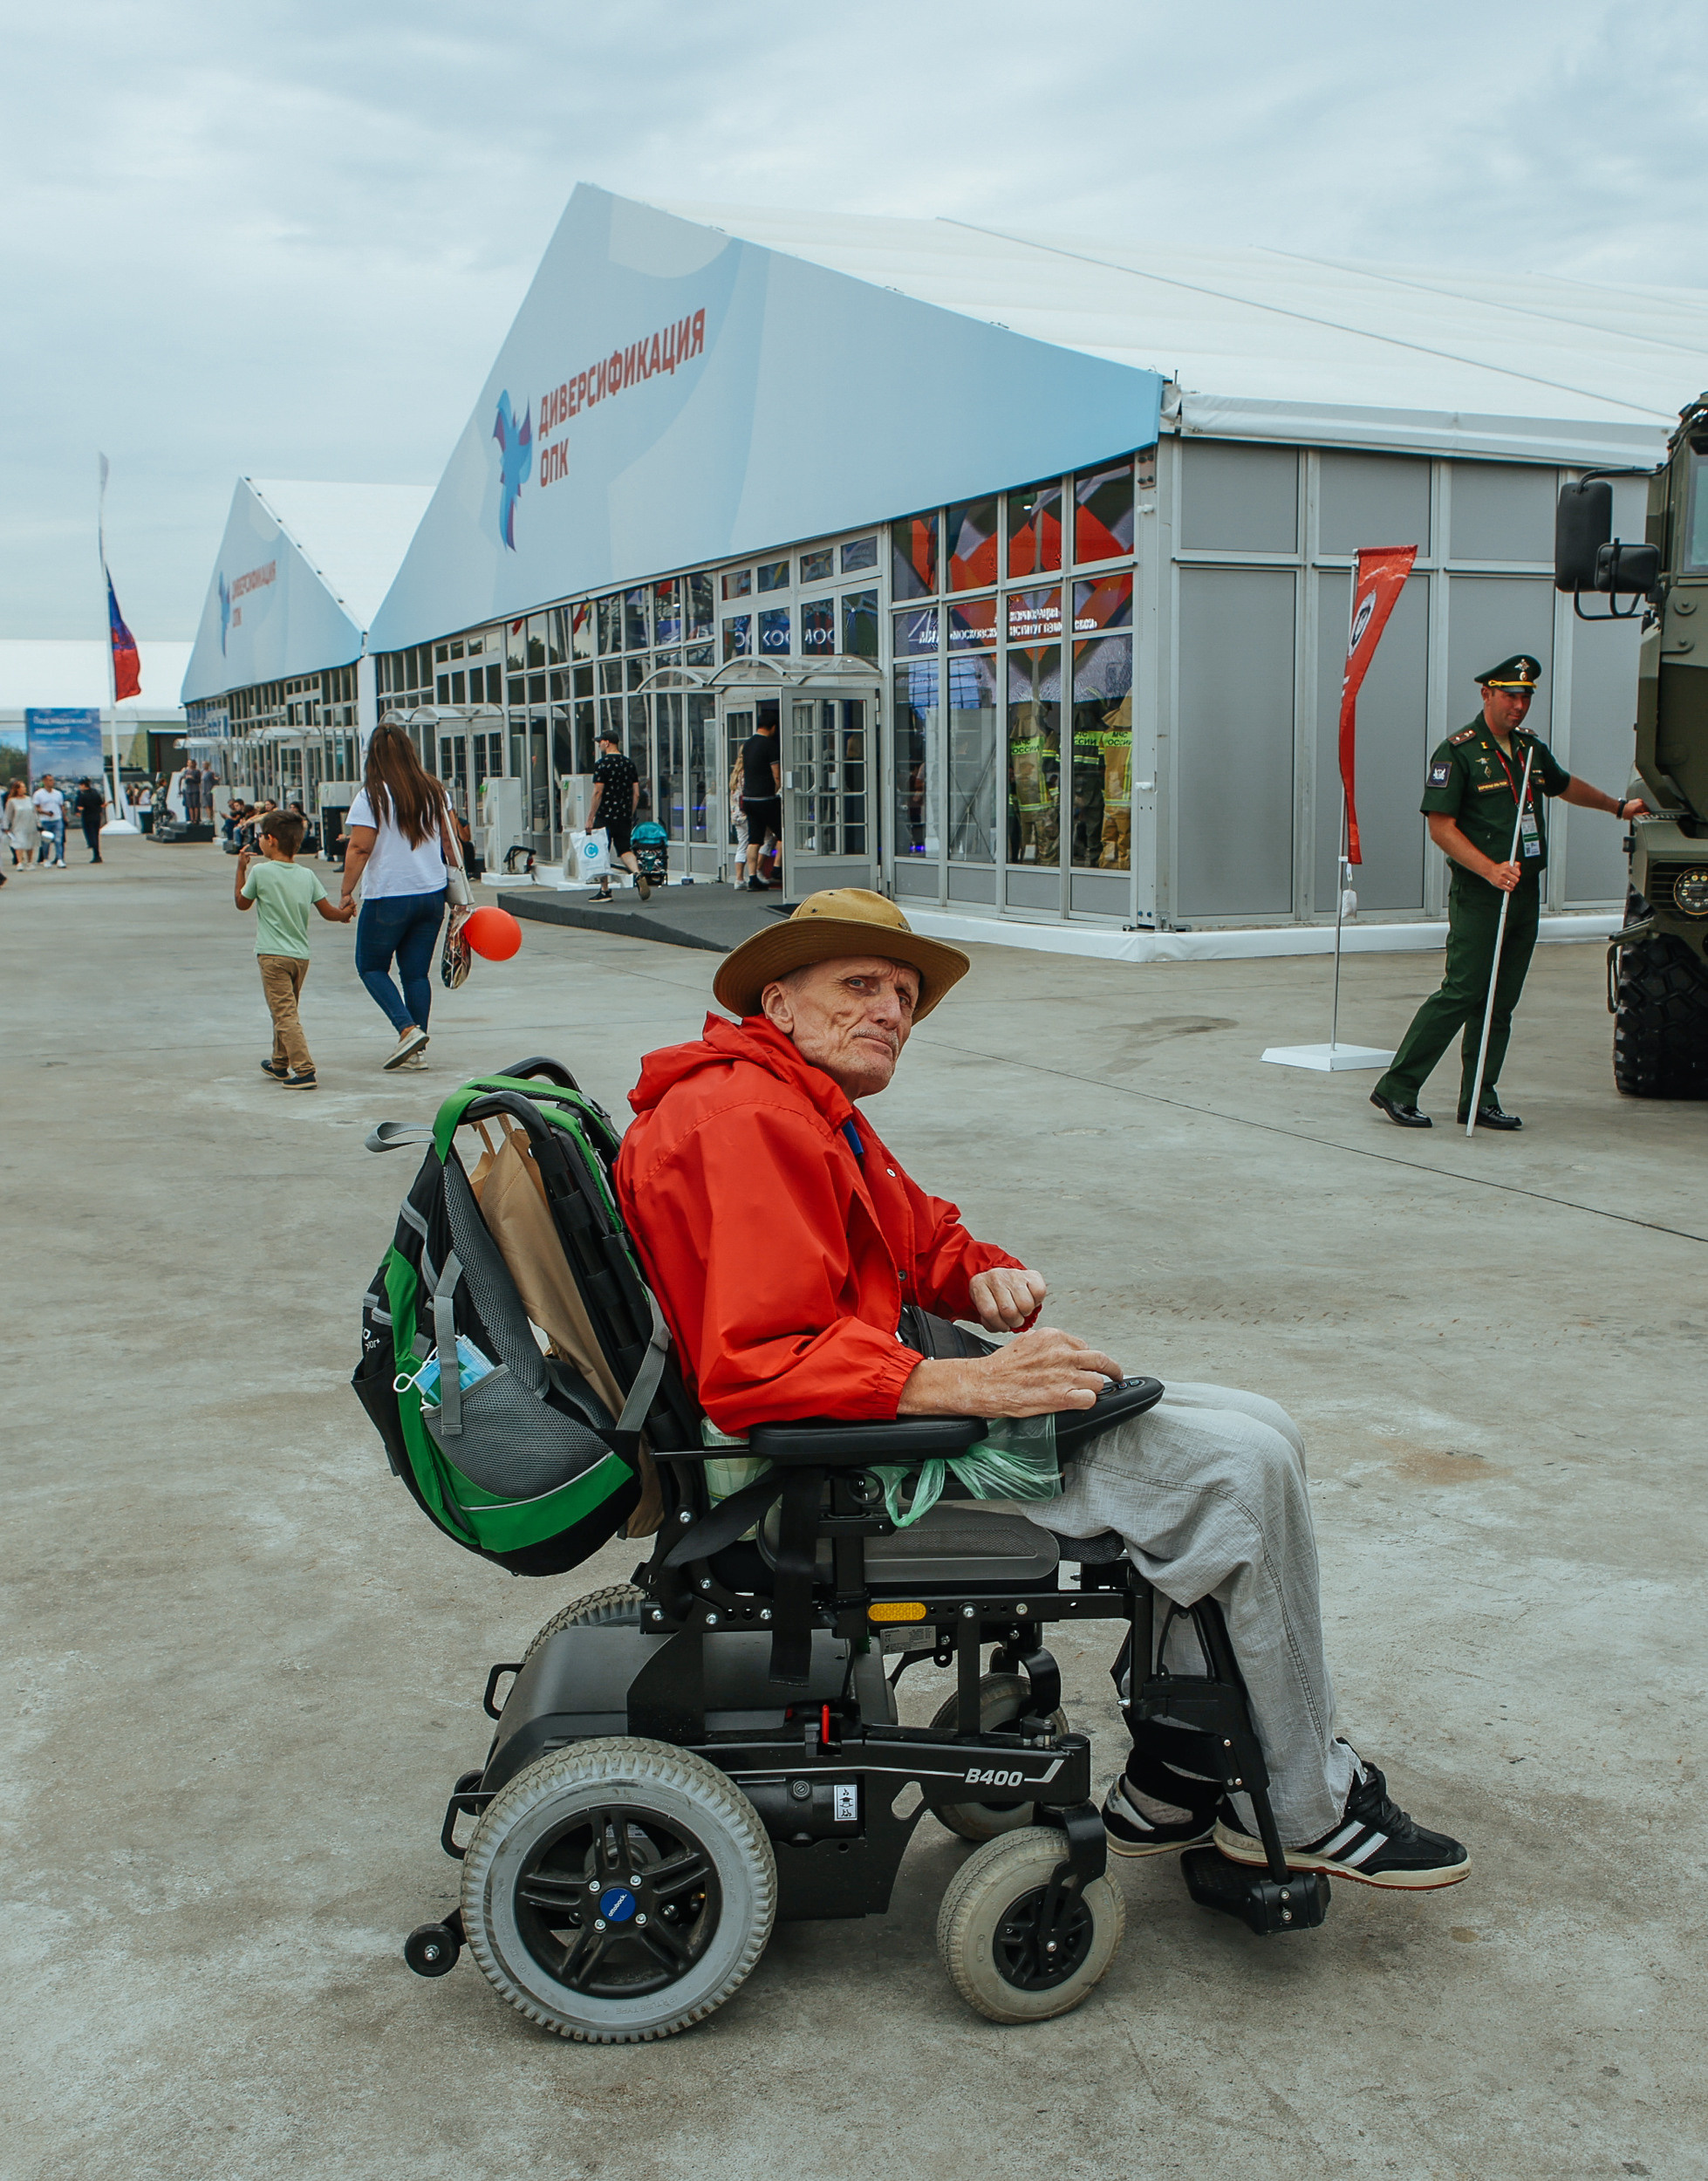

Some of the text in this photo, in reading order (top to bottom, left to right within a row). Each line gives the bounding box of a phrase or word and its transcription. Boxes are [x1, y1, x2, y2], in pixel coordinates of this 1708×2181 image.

[537, 307, 706, 441] ДИВЕРСИФИКАЦИЯ
[540, 437, 570, 488] ОПК
[1011, 745, 1040, 755] ОССИИ
[965, 1767, 1023, 1787] B400
